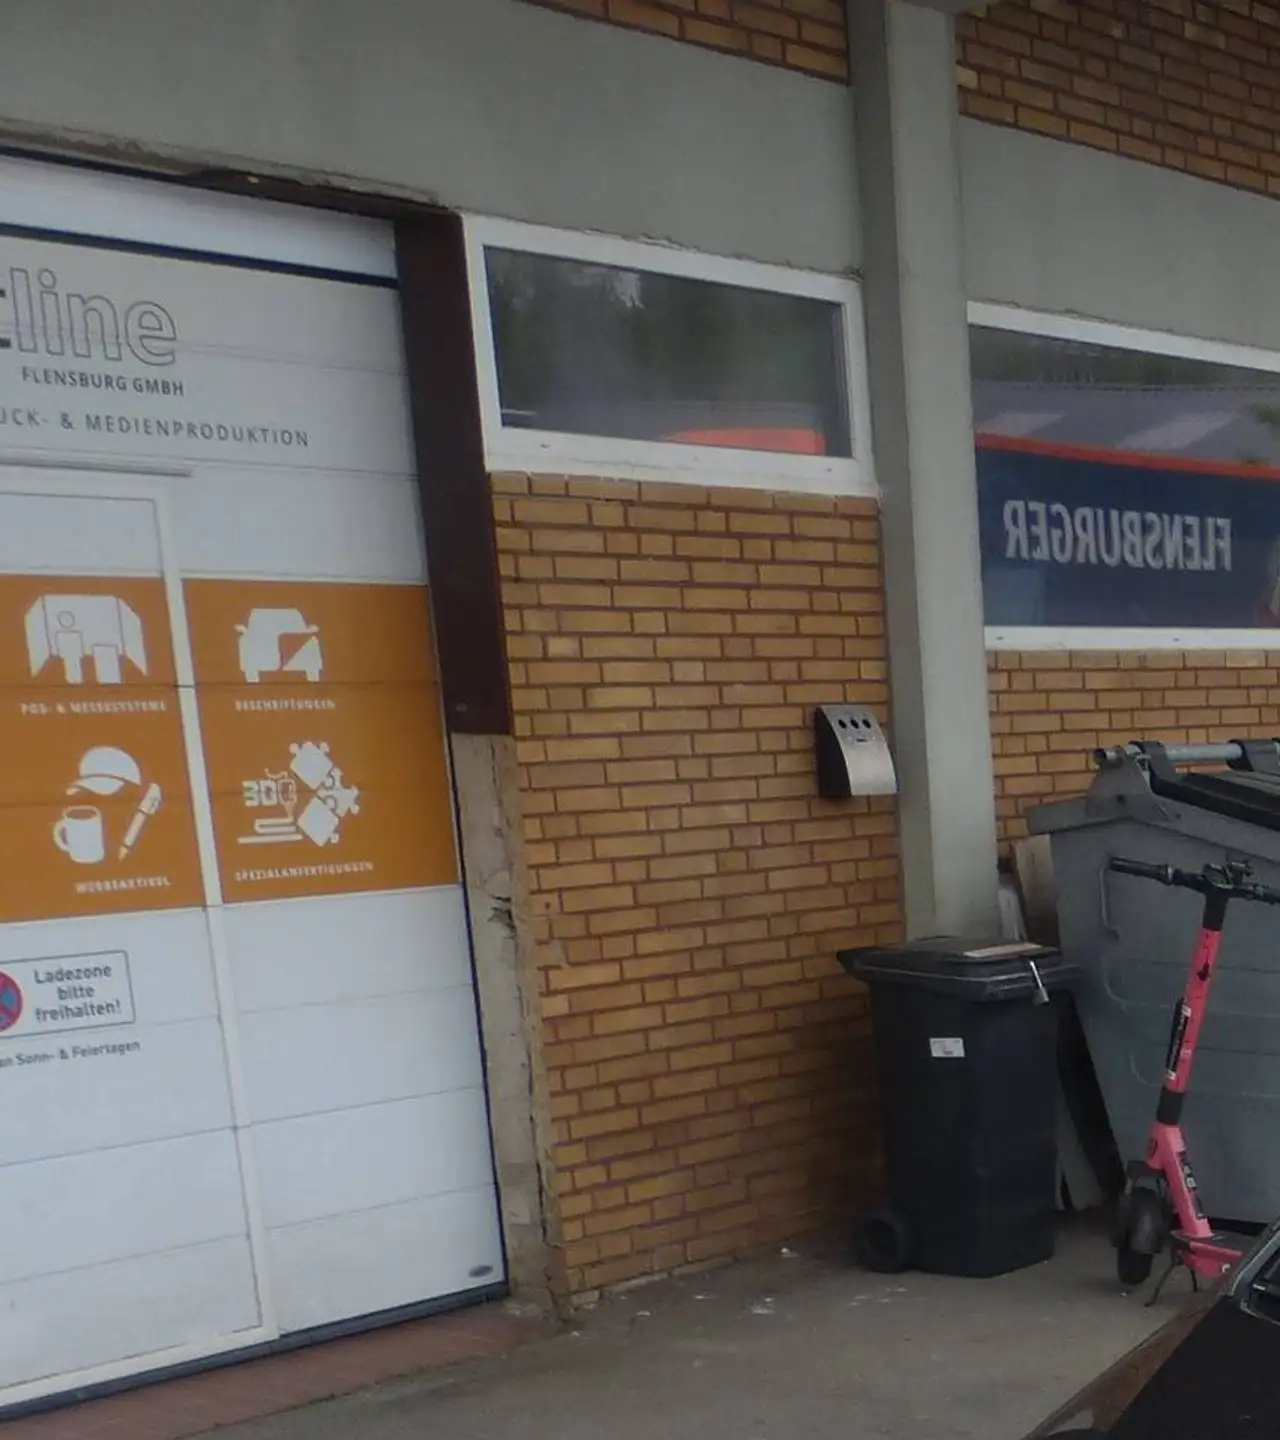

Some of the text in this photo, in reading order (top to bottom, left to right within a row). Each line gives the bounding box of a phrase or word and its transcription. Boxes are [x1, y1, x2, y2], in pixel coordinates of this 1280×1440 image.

[0, 266, 177, 367] line
[22, 366, 184, 397] FLENSBURG GMBH
[60, 412, 73, 430] &
[85, 413, 309, 447] MEDIENPRODUKTION
[34, 964, 112, 984] Ladezone
[57, 985, 95, 1000] bitte
[35, 998, 121, 1022] freihalten!
[15, 1053, 54, 1066] Sonn-
[60, 1048, 69, 1060] &
[72, 1041, 140, 1060] Feiertagen
